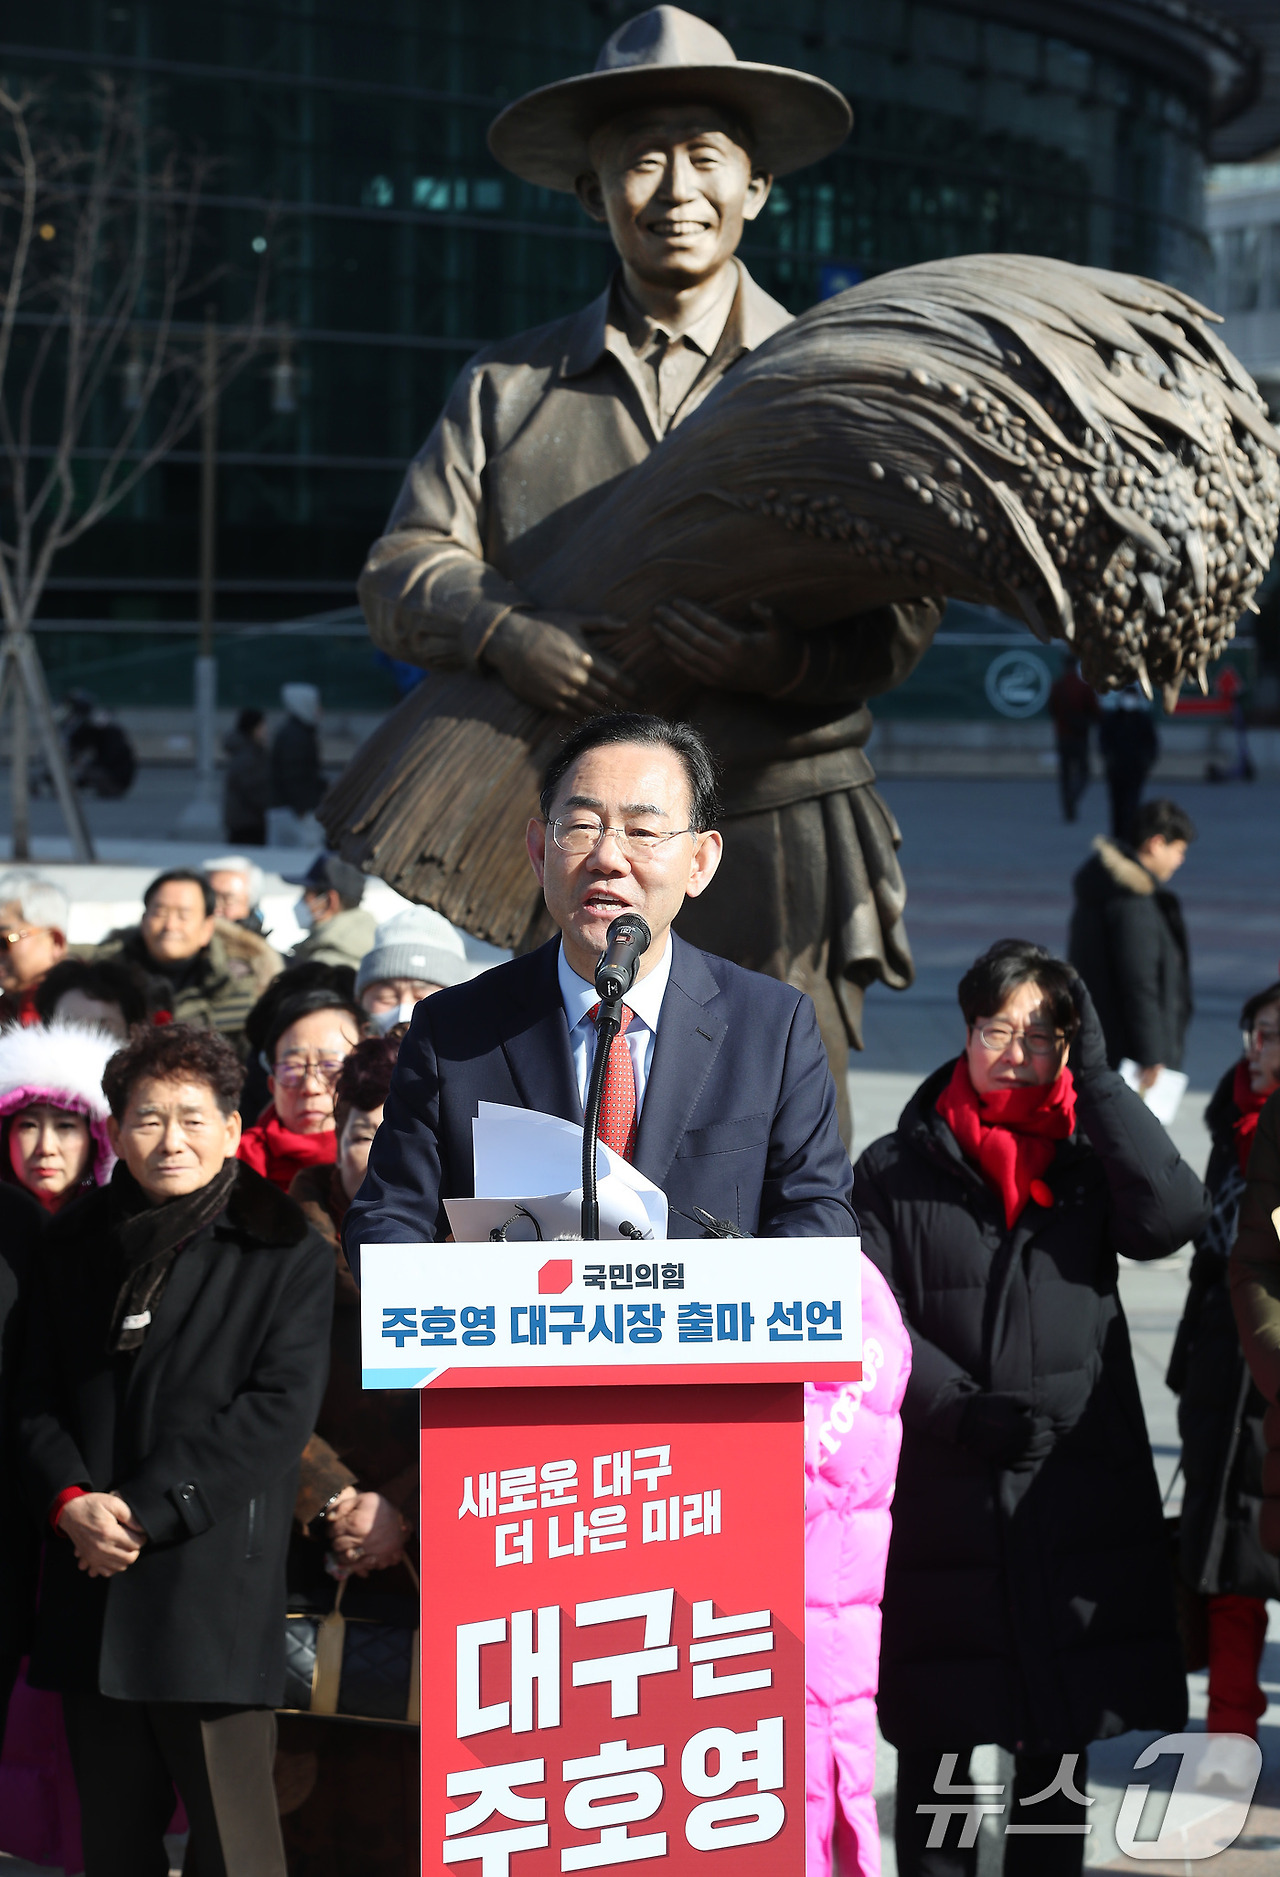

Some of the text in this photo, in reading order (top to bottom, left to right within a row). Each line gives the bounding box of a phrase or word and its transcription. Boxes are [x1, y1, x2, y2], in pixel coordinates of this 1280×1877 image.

[583, 1263, 685, 1290] 국민의힘
[381, 1300, 843, 1347] 주호영 대구시장 출마 선언
[459, 1445, 672, 1520] 새로운 대구
[495, 1490, 721, 1567] 더 나은 미래
[456, 1588, 775, 1740] 대구는
[443, 1715, 786, 1877] 주호영
